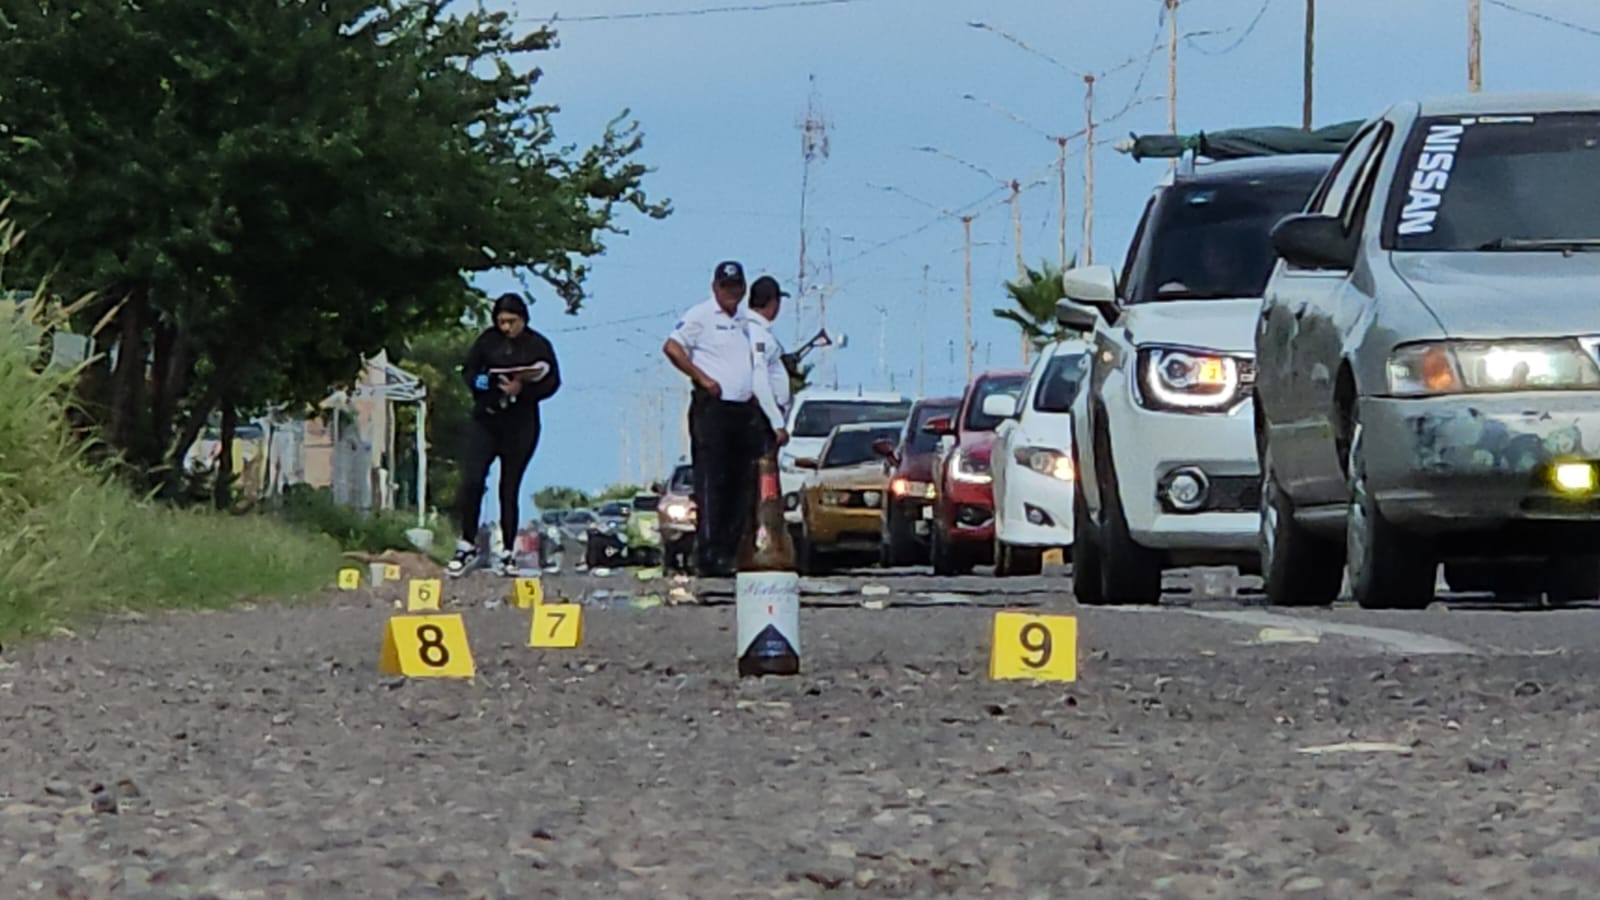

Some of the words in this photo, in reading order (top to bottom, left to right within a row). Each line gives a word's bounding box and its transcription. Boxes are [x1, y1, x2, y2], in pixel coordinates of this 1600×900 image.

[1398, 125, 1464, 235] NISSAN
[418, 584, 431, 601] 6
[416, 624, 450, 667] 8
[546, 612, 567, 638] 7
[1020, 622, 1053, 669] 9
